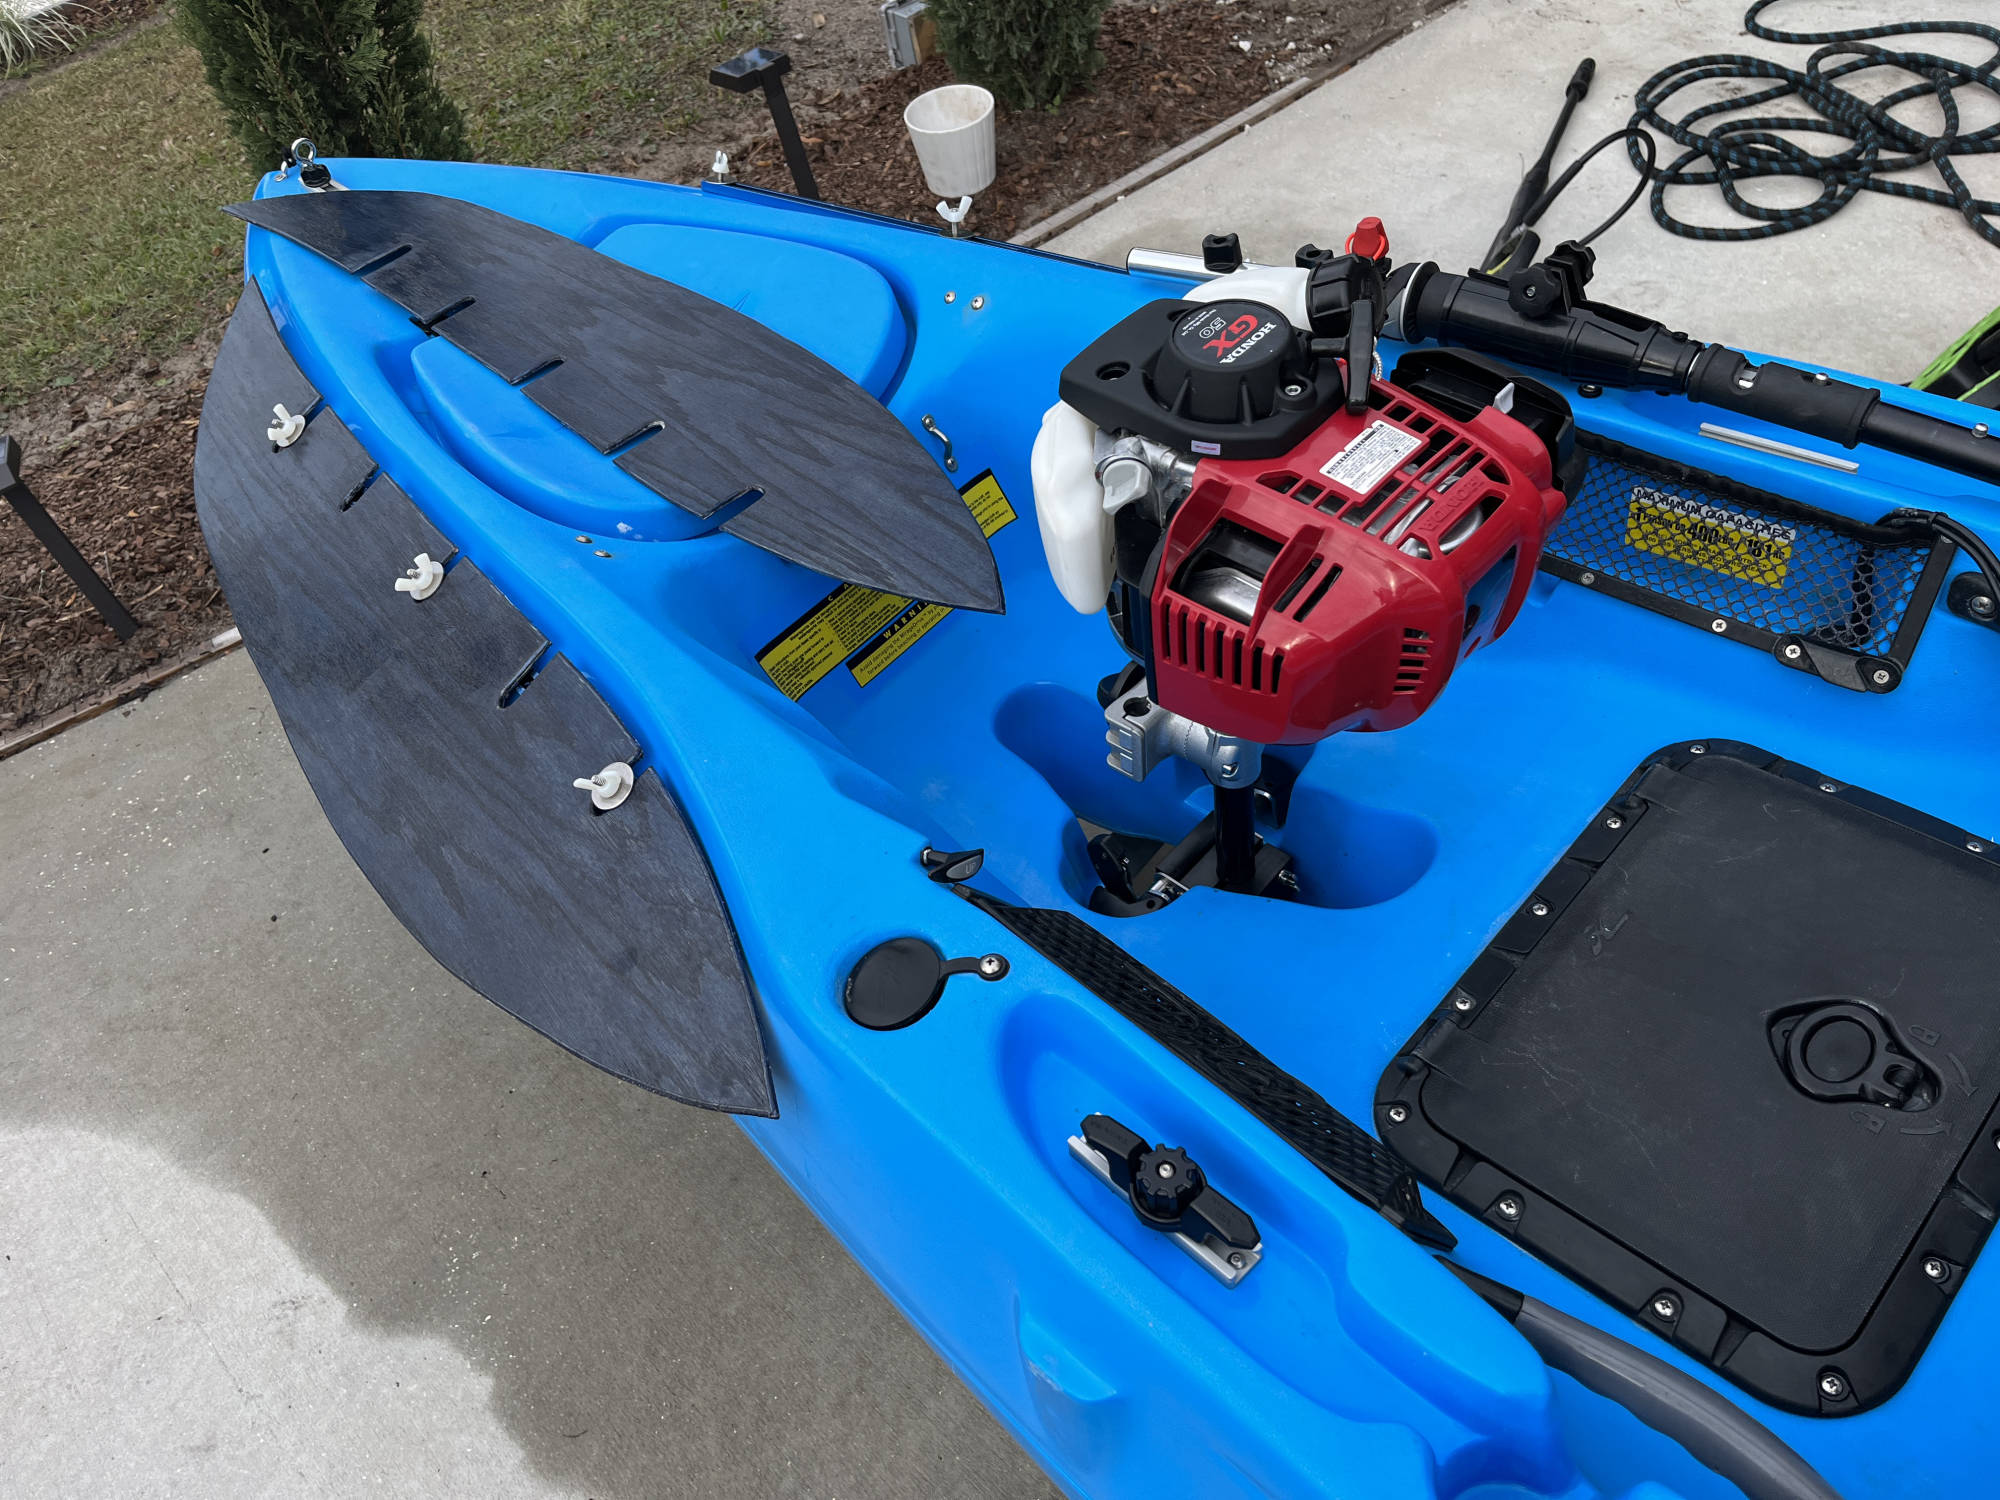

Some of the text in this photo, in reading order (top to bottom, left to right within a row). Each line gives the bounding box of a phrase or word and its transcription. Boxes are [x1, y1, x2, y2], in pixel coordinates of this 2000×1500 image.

[1199, 316, 1226, 339] 50
[1202, 314, 1258, 358] GX
[1219, 322, 1277, 363] HONDA
[1418, 481, 1487, 531] HONDA
